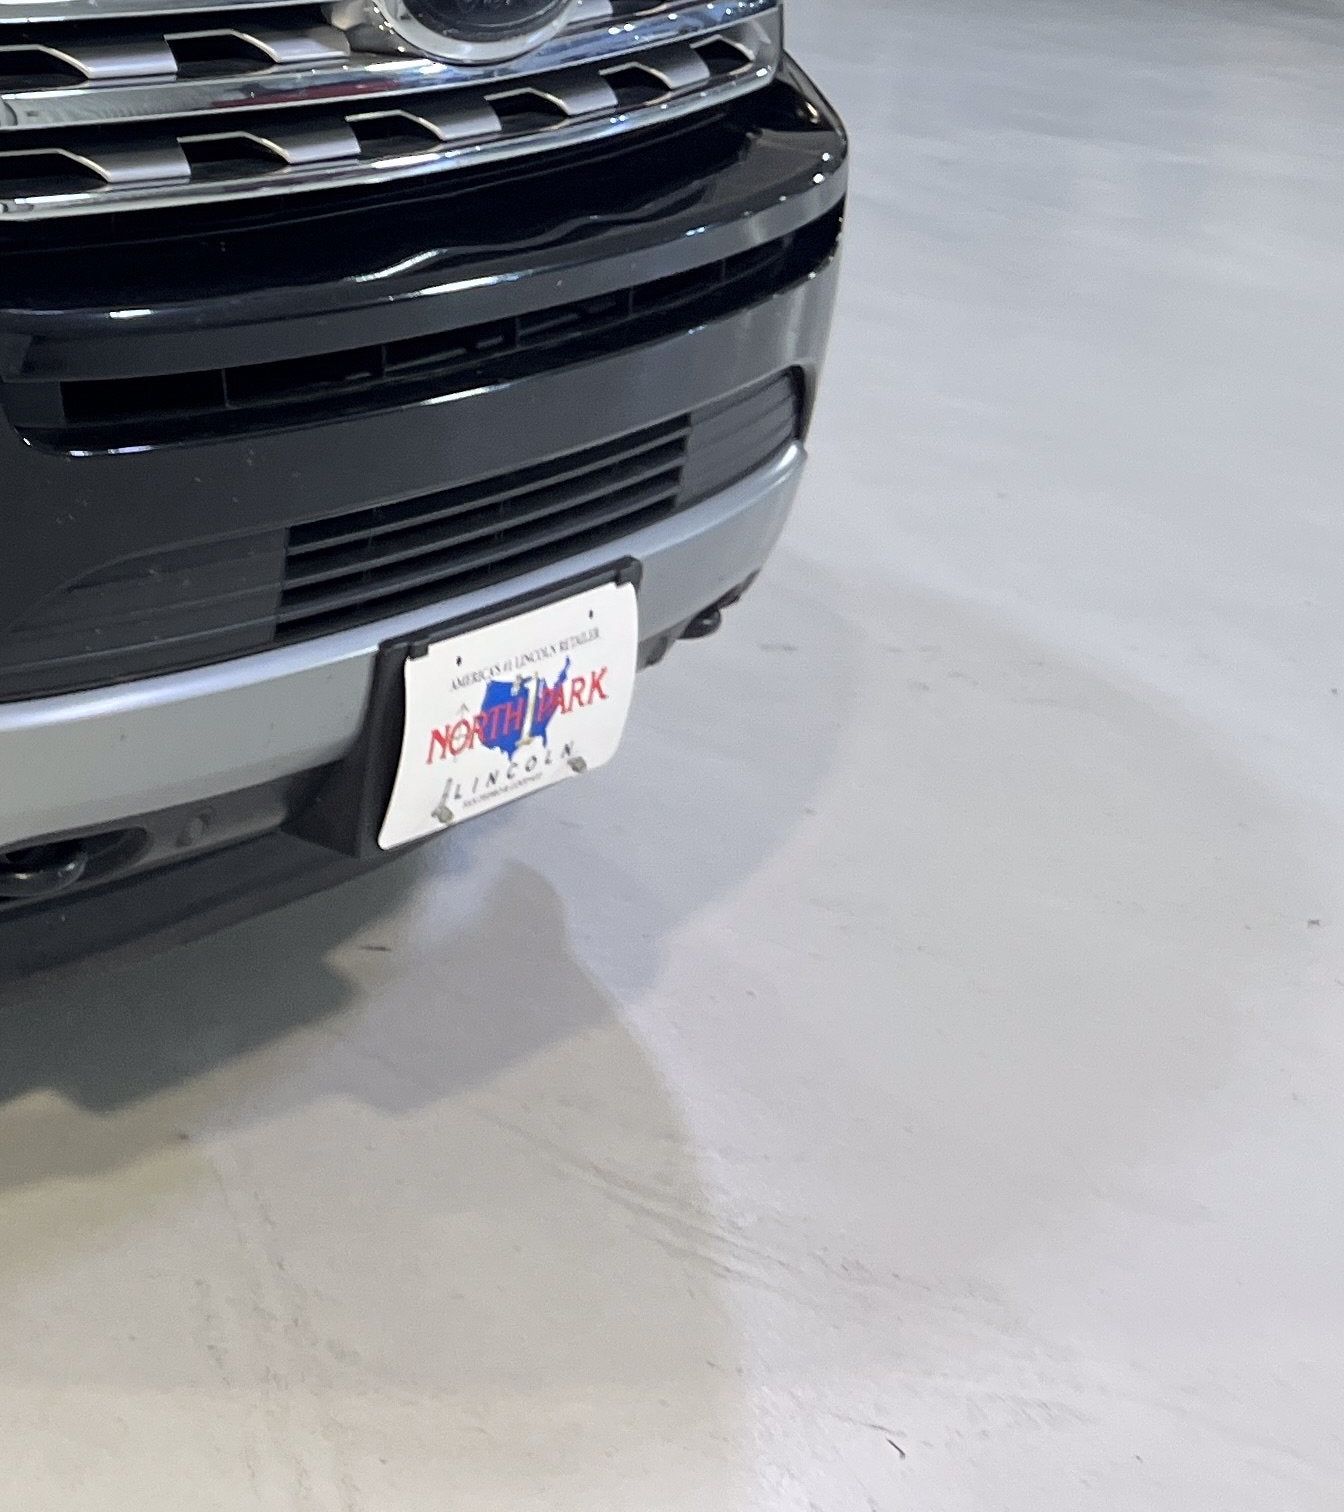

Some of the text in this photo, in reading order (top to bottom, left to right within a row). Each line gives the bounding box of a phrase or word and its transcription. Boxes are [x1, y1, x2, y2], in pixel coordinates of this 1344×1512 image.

[425, 666, 609, 765] NORTH PARK
[453, 739, 575, 800] LINCOLN
